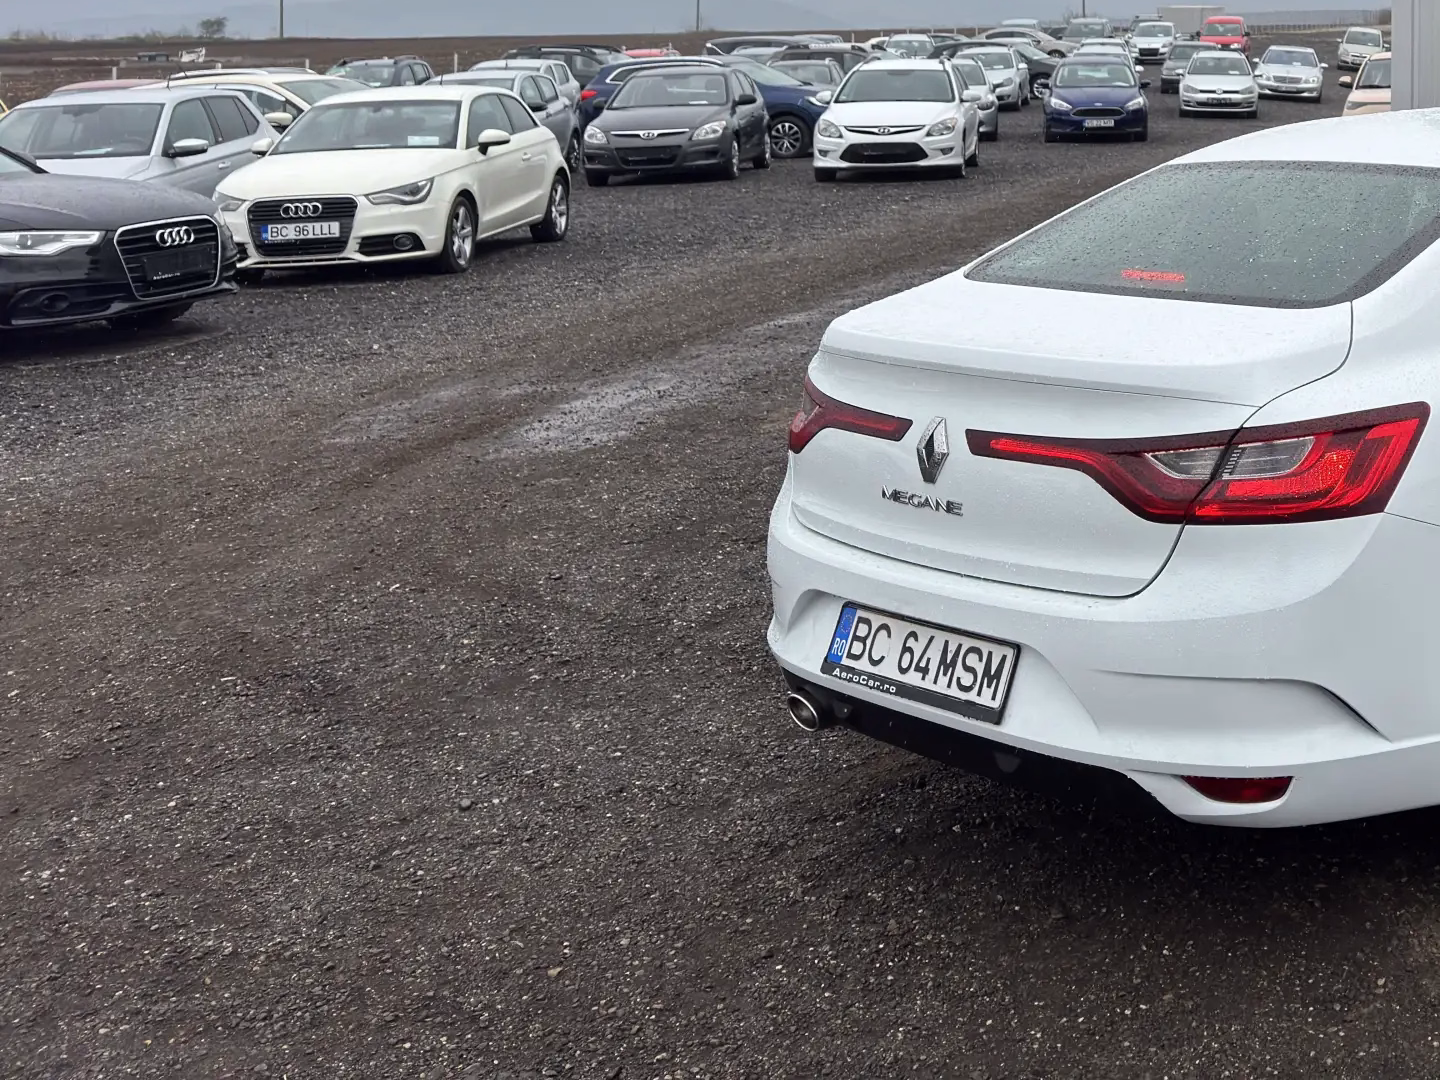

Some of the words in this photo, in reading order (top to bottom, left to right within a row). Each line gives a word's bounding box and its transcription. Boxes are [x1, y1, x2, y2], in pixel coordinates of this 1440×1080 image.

[270, 226, 288, 238] BC
[294, 225, 310, 237] 96
[312, 223, 337, 236] LLL
[881, 485, 963, 516] MEGANE
[831, 637, 846, 657] RO
[846, 615, 892, 667] BC
[831, 667, 897, 694] AeroCar.ro
